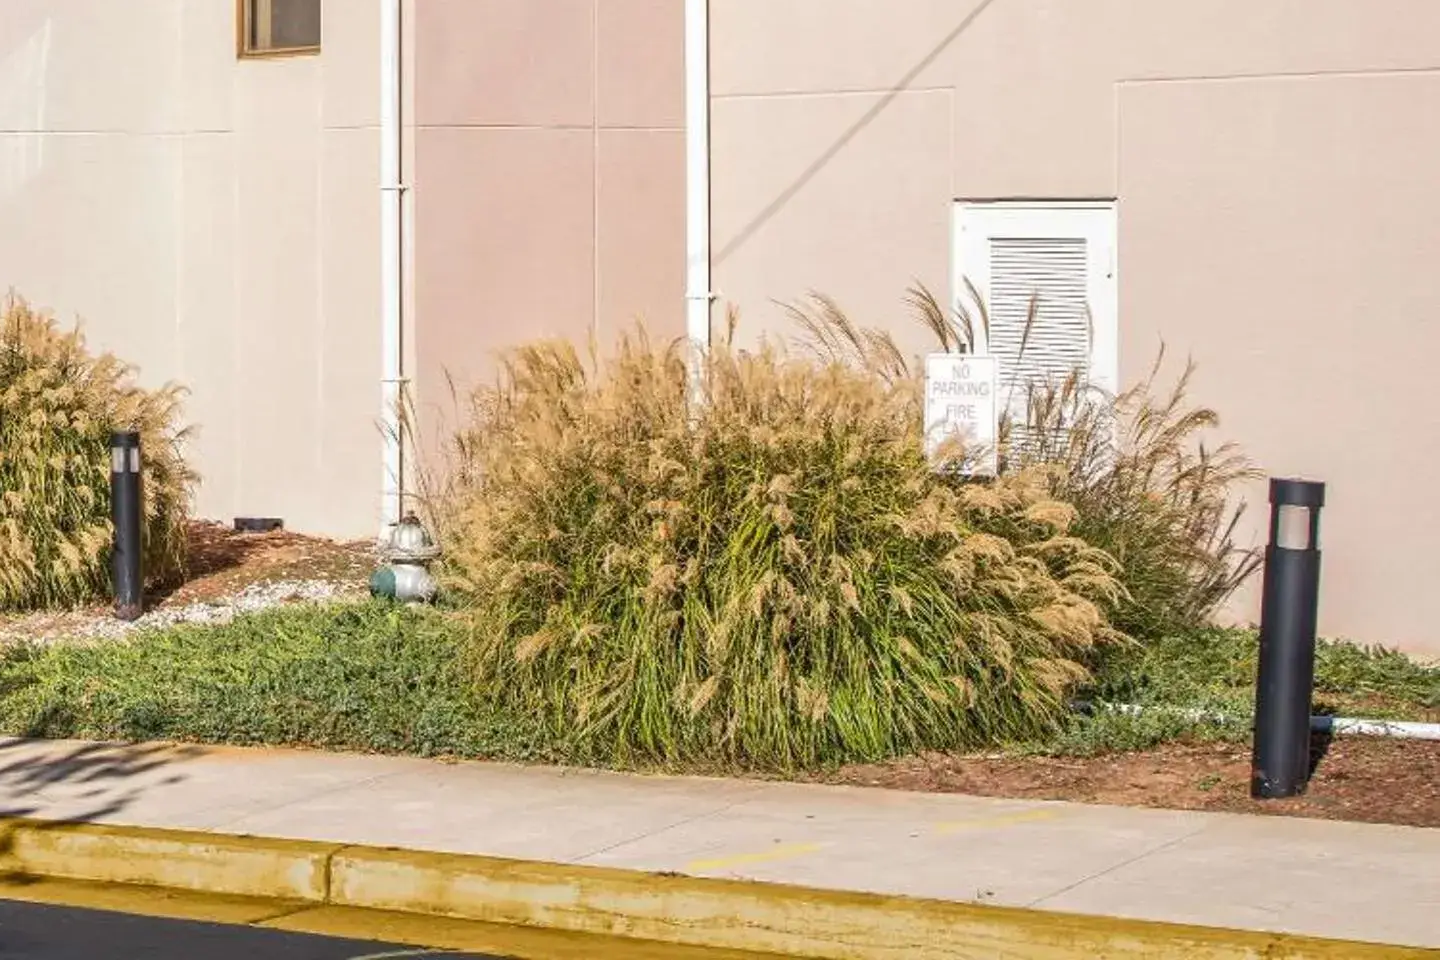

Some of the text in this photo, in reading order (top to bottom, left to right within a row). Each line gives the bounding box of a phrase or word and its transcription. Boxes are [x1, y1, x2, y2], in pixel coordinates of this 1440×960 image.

[953, 364, 970, 378] NO
[933, 381, 989, 396] PARKING
[947, 404, 976, 419] FIRE
[943, 422, 977, 436] LAE
